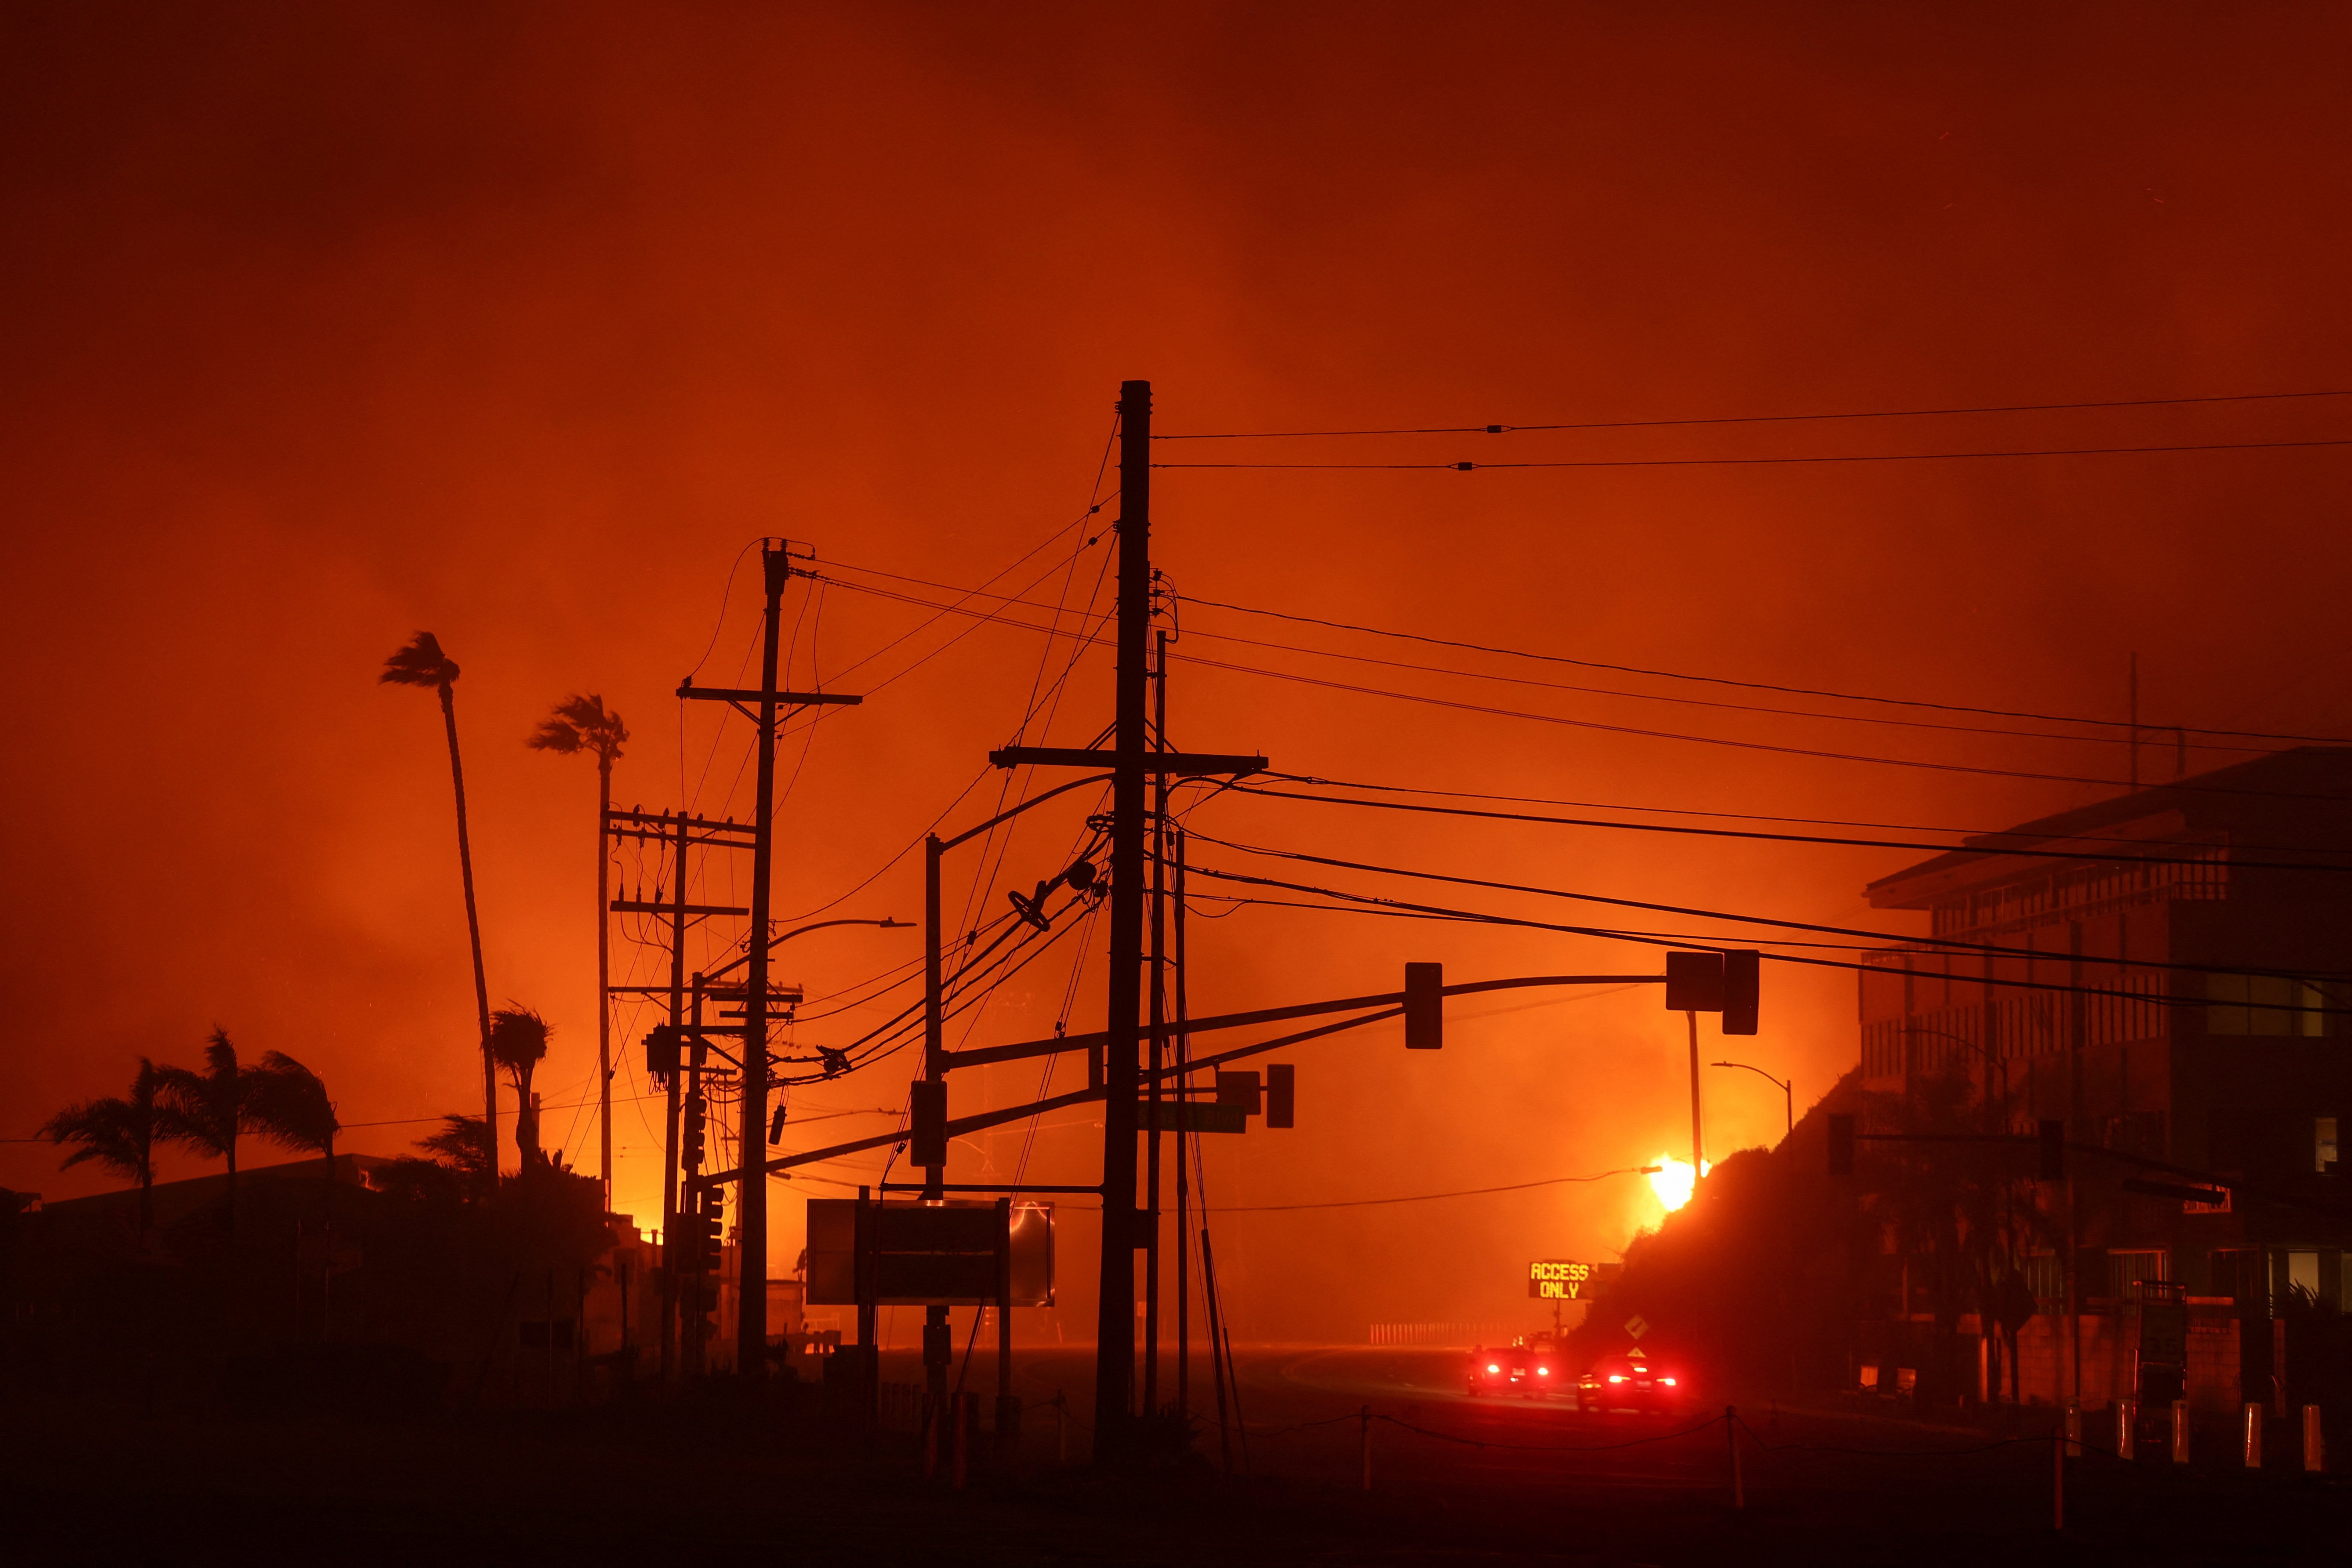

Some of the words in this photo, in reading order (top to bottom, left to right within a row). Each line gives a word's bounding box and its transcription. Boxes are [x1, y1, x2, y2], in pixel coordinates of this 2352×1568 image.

[1531, 1262, 1589, 1281] ACCESS
[1540, 1281, 1579, 1299] ONLY
[2148, 1336, 2178, 1355] 35
